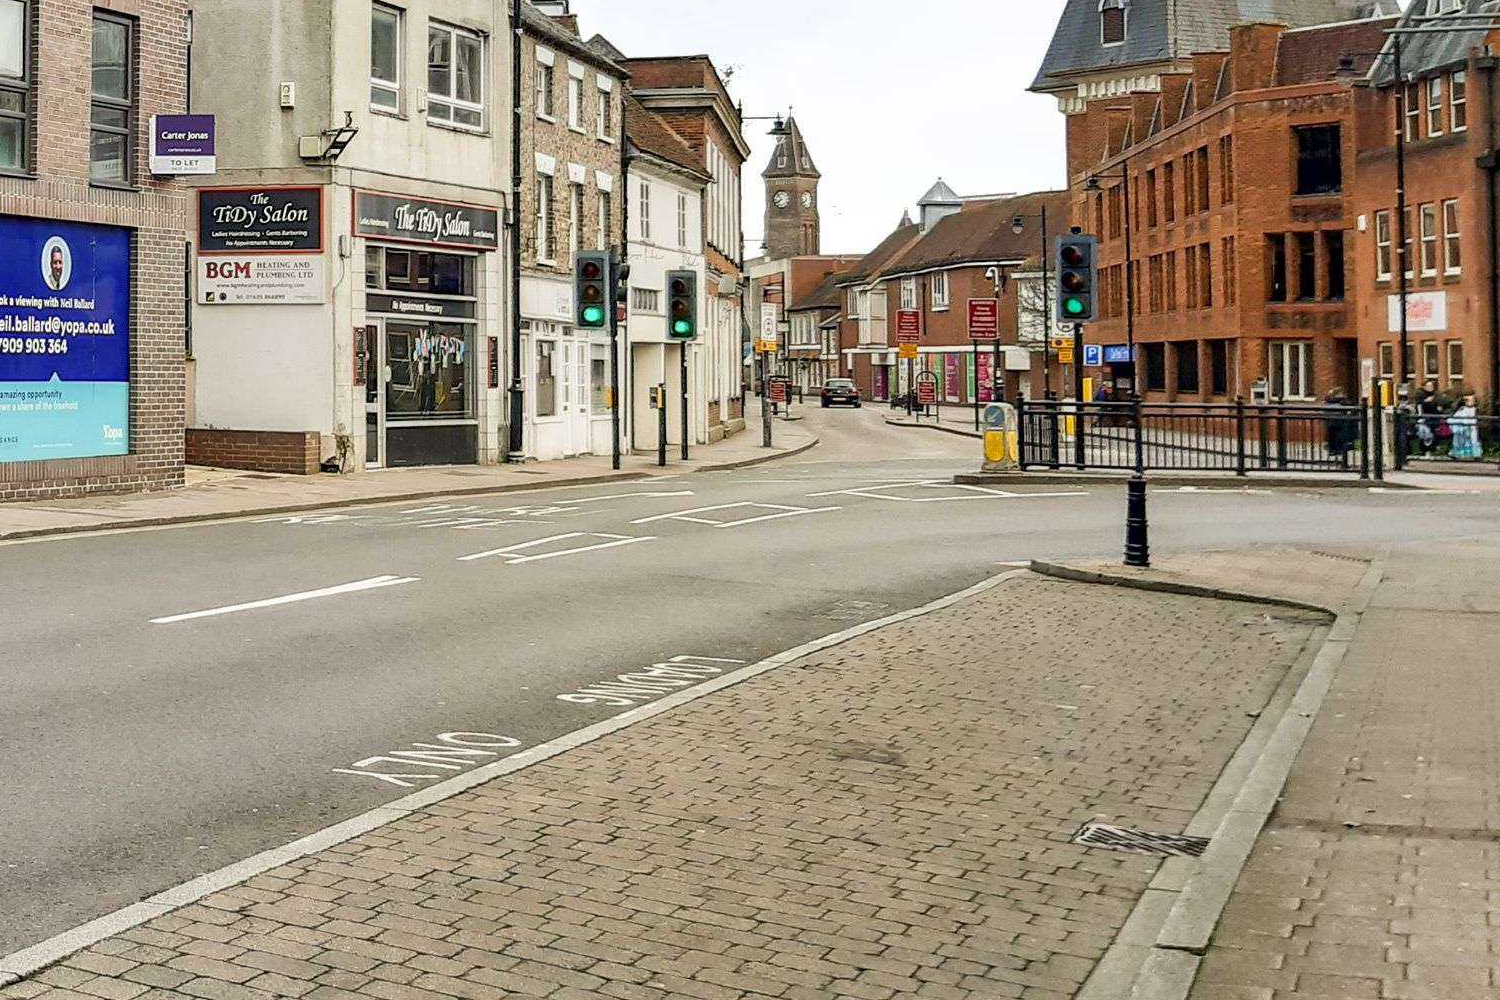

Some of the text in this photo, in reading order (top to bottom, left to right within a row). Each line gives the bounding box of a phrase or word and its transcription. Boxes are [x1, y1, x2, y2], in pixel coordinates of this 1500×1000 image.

[161, 131, 209, 141] Carter Jonas
[250, 192, 270, 205] The
[213, 202, 309, 229] TiDy Salon
[394, 203, 470, 242] The TiDy Salon
[205, 261, 311, 279] BGM HEATING AND
[255, 271, 314, 279] PLUMBING LTD
[9, 296, 14, 306] a
[15, 295, 43, 310] viewing
[43, 295, 59, 308] with
[60, 297, 73, 308] Neil
[74, 298, 95, 310] Ballard
[25, 337, 46, 354] 903
[47, 338, 68, 354] 364
[0, 389, 26, 400] amazing
[26, 389, 62, 400] opportunity
[332, 730, 523, 788] ONLY
